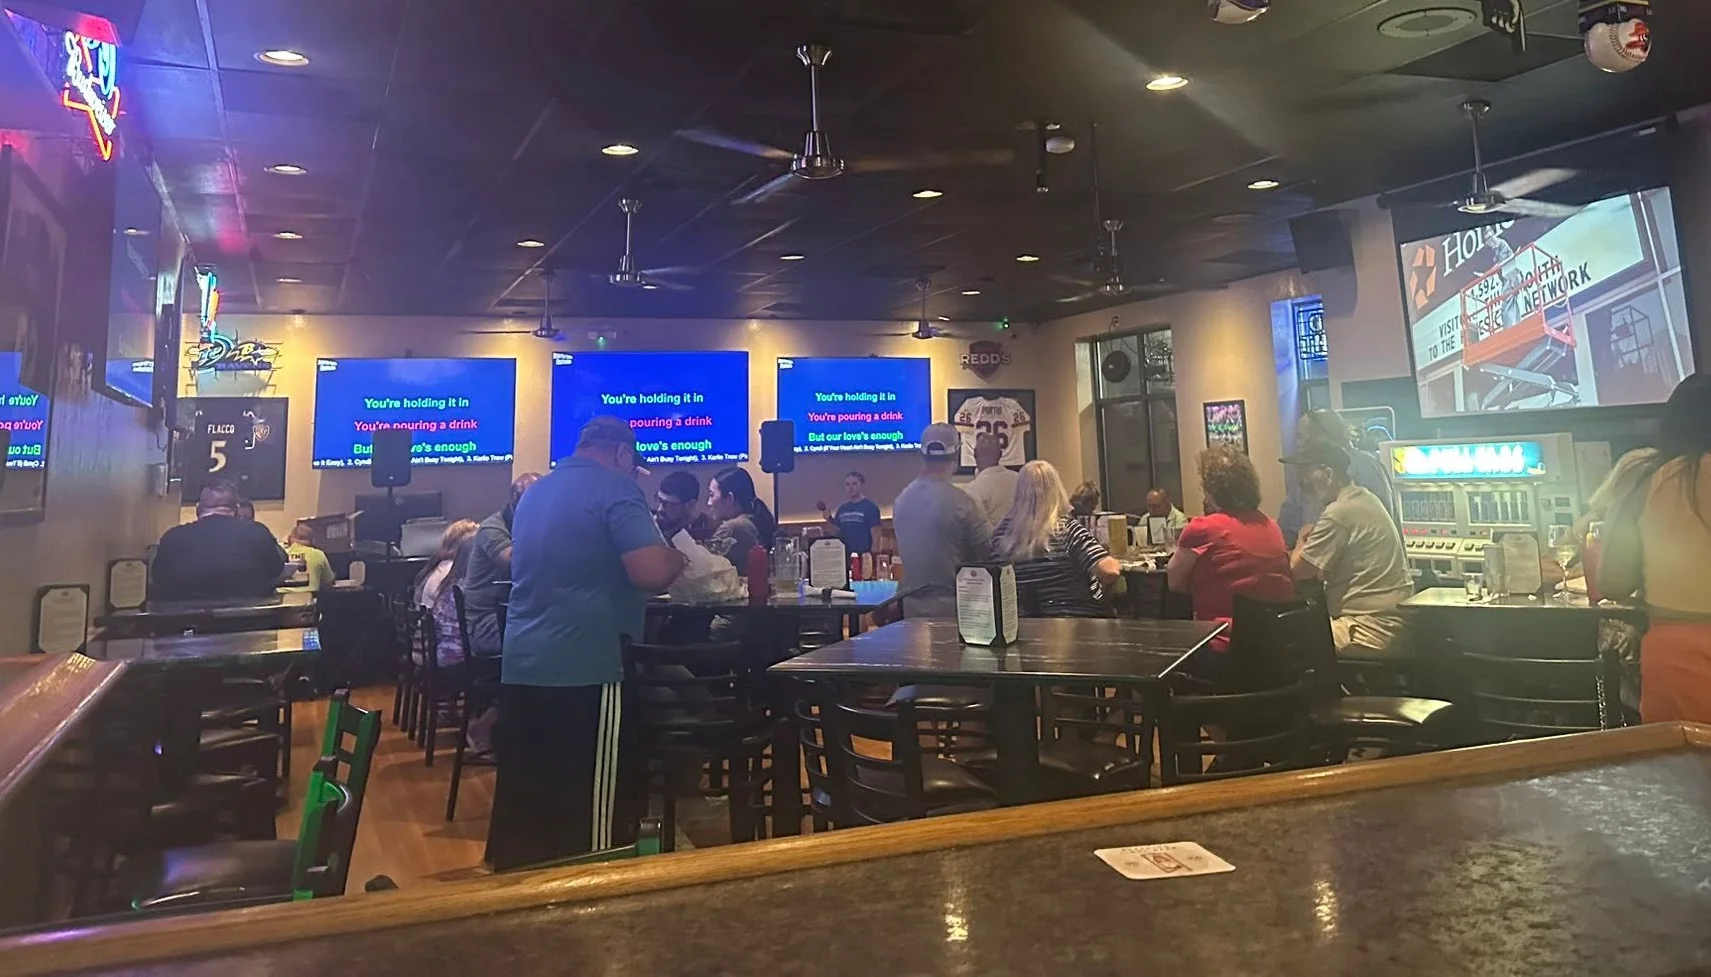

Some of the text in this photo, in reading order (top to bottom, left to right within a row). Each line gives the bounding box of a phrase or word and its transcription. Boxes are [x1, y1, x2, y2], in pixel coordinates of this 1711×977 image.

[1428, 347, 1439, 361] TO
[1441, 335, 1456, 352] THE
[1523, 261, 1592, 313] NETWORK
[1438, 316, 1461, 338] VISIT
[364, 397, 469, 410] You're holding it in
[601, 393, 704, 406] You're holding it in
[815, 392, 896, 403] You're holding it in
[629, 417, 673, 429] pouring
[685, 416, 713, 426] drink
[808, 412, 836, 421] You're
[838, 412, 872, 423] pouring
[881, 411, 903, 420] drink
[960, 412, 972, 423] 26
[1013, 411, 1026, 423] 26
[207, 424, 235, 434] FLACCO
[354, 421, 391, 432] You're
[439, 421, 447, 430] a
[449, 419, 478, 430] drink
[808, 431, 904, 441] But our love's enough
[434, 441, 477, 454] enough
[635, 439, 712, 452] love's enough
[208, 440, 227, 473] 5
